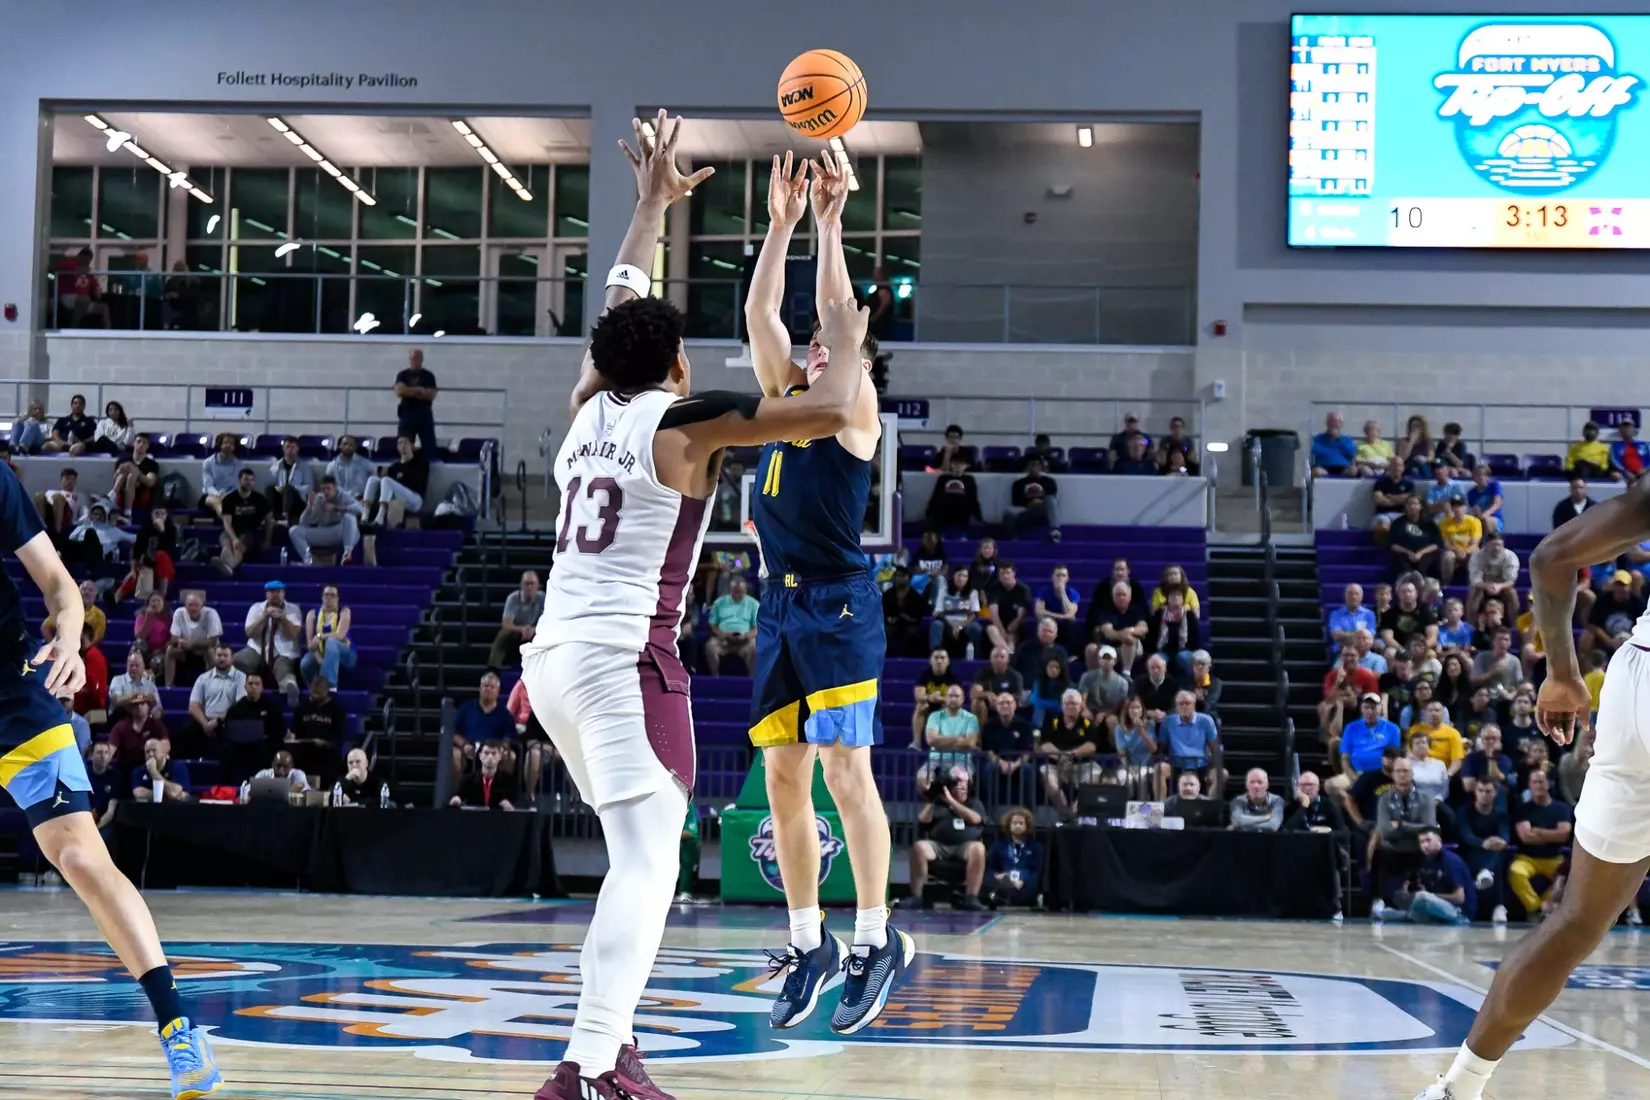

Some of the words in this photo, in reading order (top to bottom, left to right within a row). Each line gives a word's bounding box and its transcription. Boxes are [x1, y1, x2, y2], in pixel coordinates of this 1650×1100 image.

[1472, 57, 1525, 72] FORT
[1531, 57, 1602, 72] MYERS
[217, 71, 266, 86] Follett
[271, 72, 354, 90] Hospitality
[358, 73, 418, 88] Pavilion
[780, 86, 814, 107] NCAA
[1434, 73, 1638, 126] Tip-Off
[1389, 205, 1424, 229] 10
[1505, 204, 1569, 228] 3:13
[223, 391, 244, 405] 111
[896, 402, 921, 416] 112
[566, 439, 617, 470] MNAIR
[762, 449, 783, 498] 11
[556, 475, 623, 555] 13
